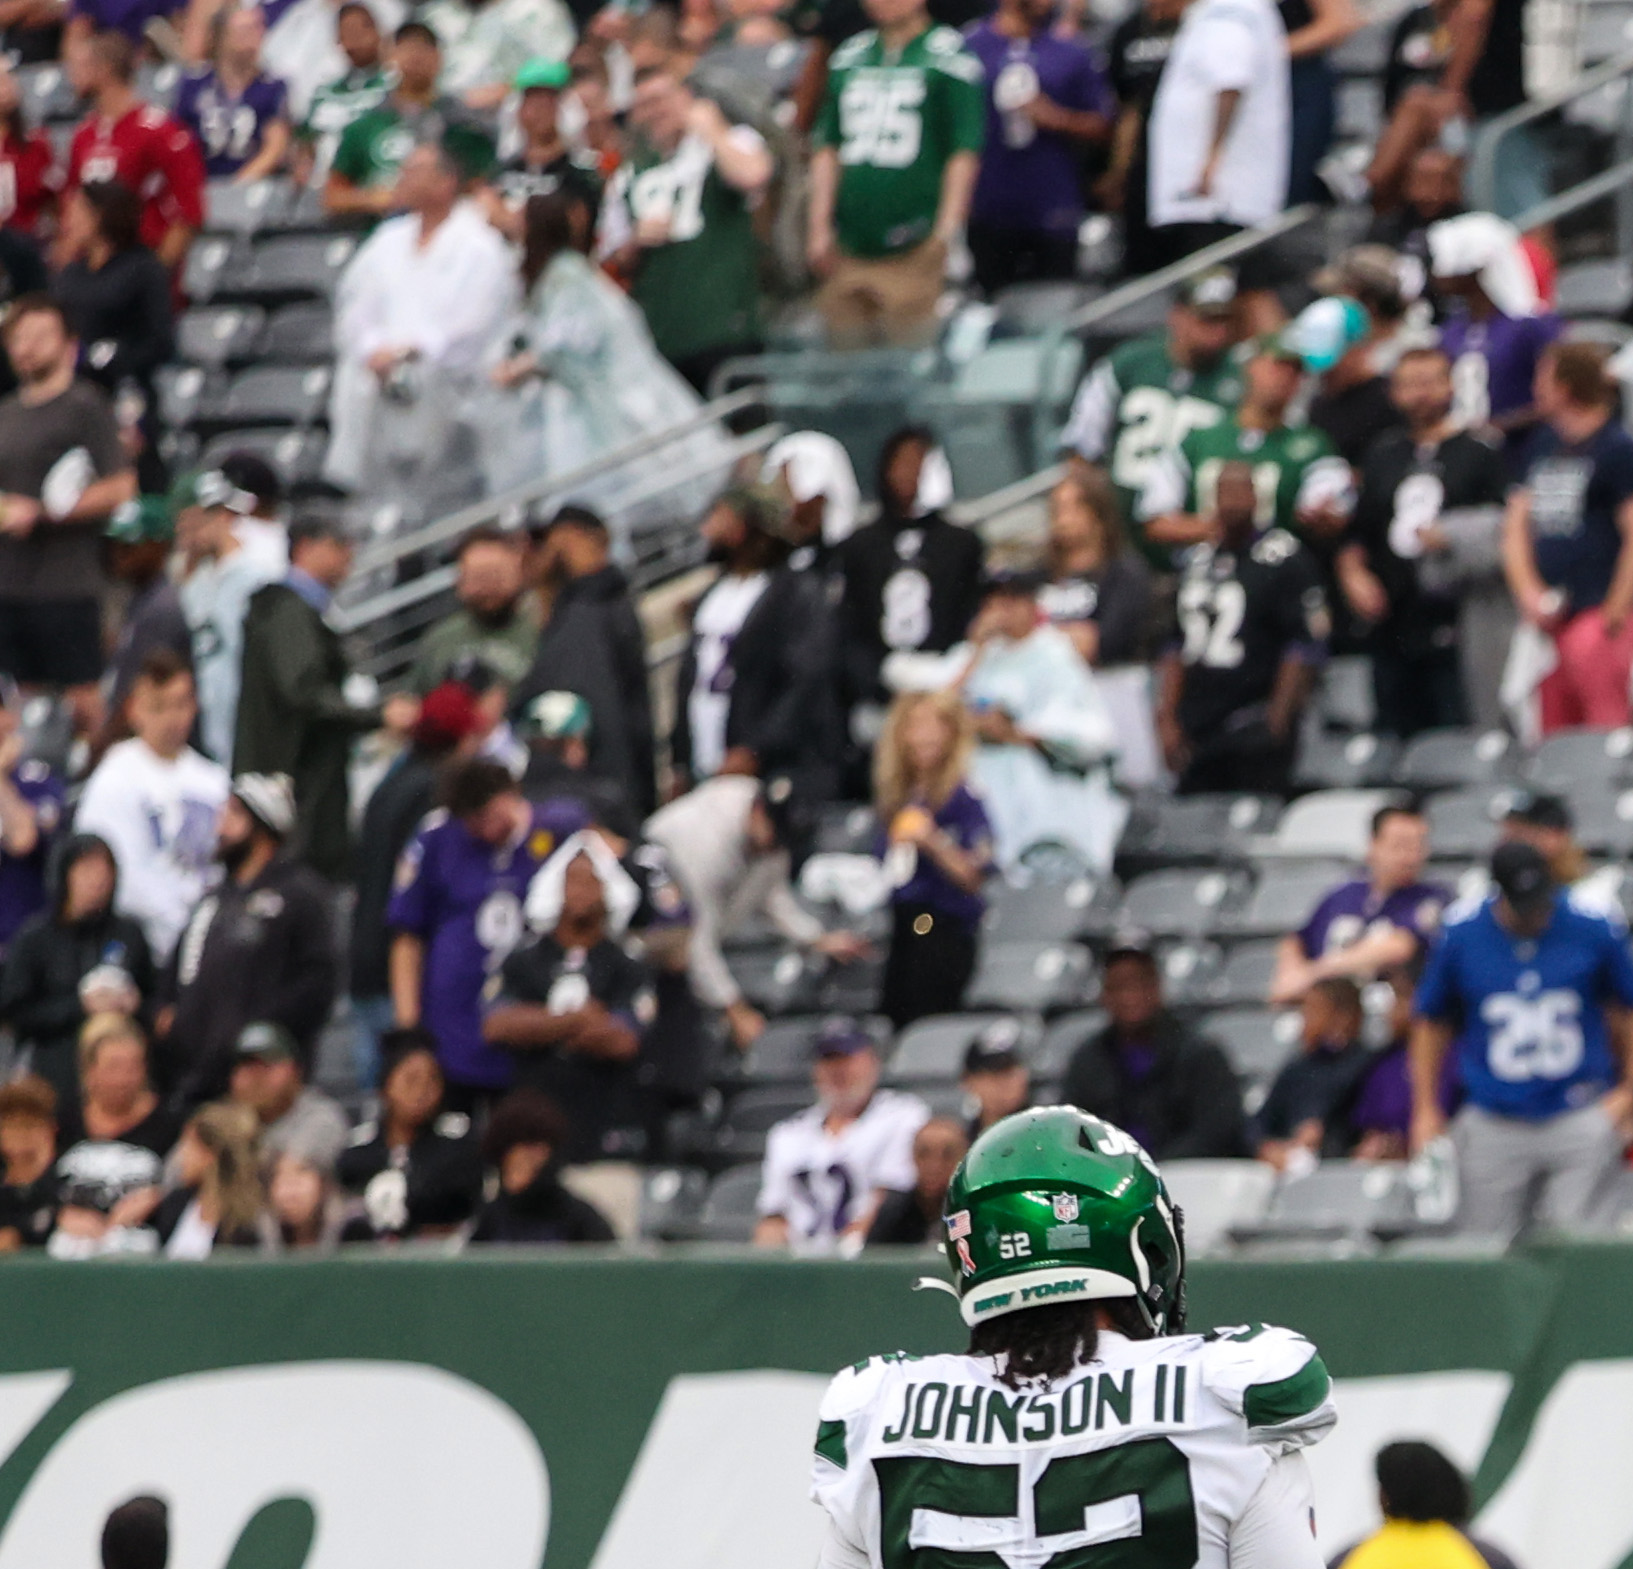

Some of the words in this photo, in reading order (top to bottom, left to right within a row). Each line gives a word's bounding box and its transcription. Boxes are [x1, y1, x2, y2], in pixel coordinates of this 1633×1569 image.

[882, 568, 932, 651] 8
[1481, 988, 1585, 1081] 26
[1000, 1231, 1032, 1259] 52
[1020, 1279, 1088, 1301] YORK
[884, 1369, 1133, 1444] JOHNSON
[1154, 1364, 1186, 1424] II
